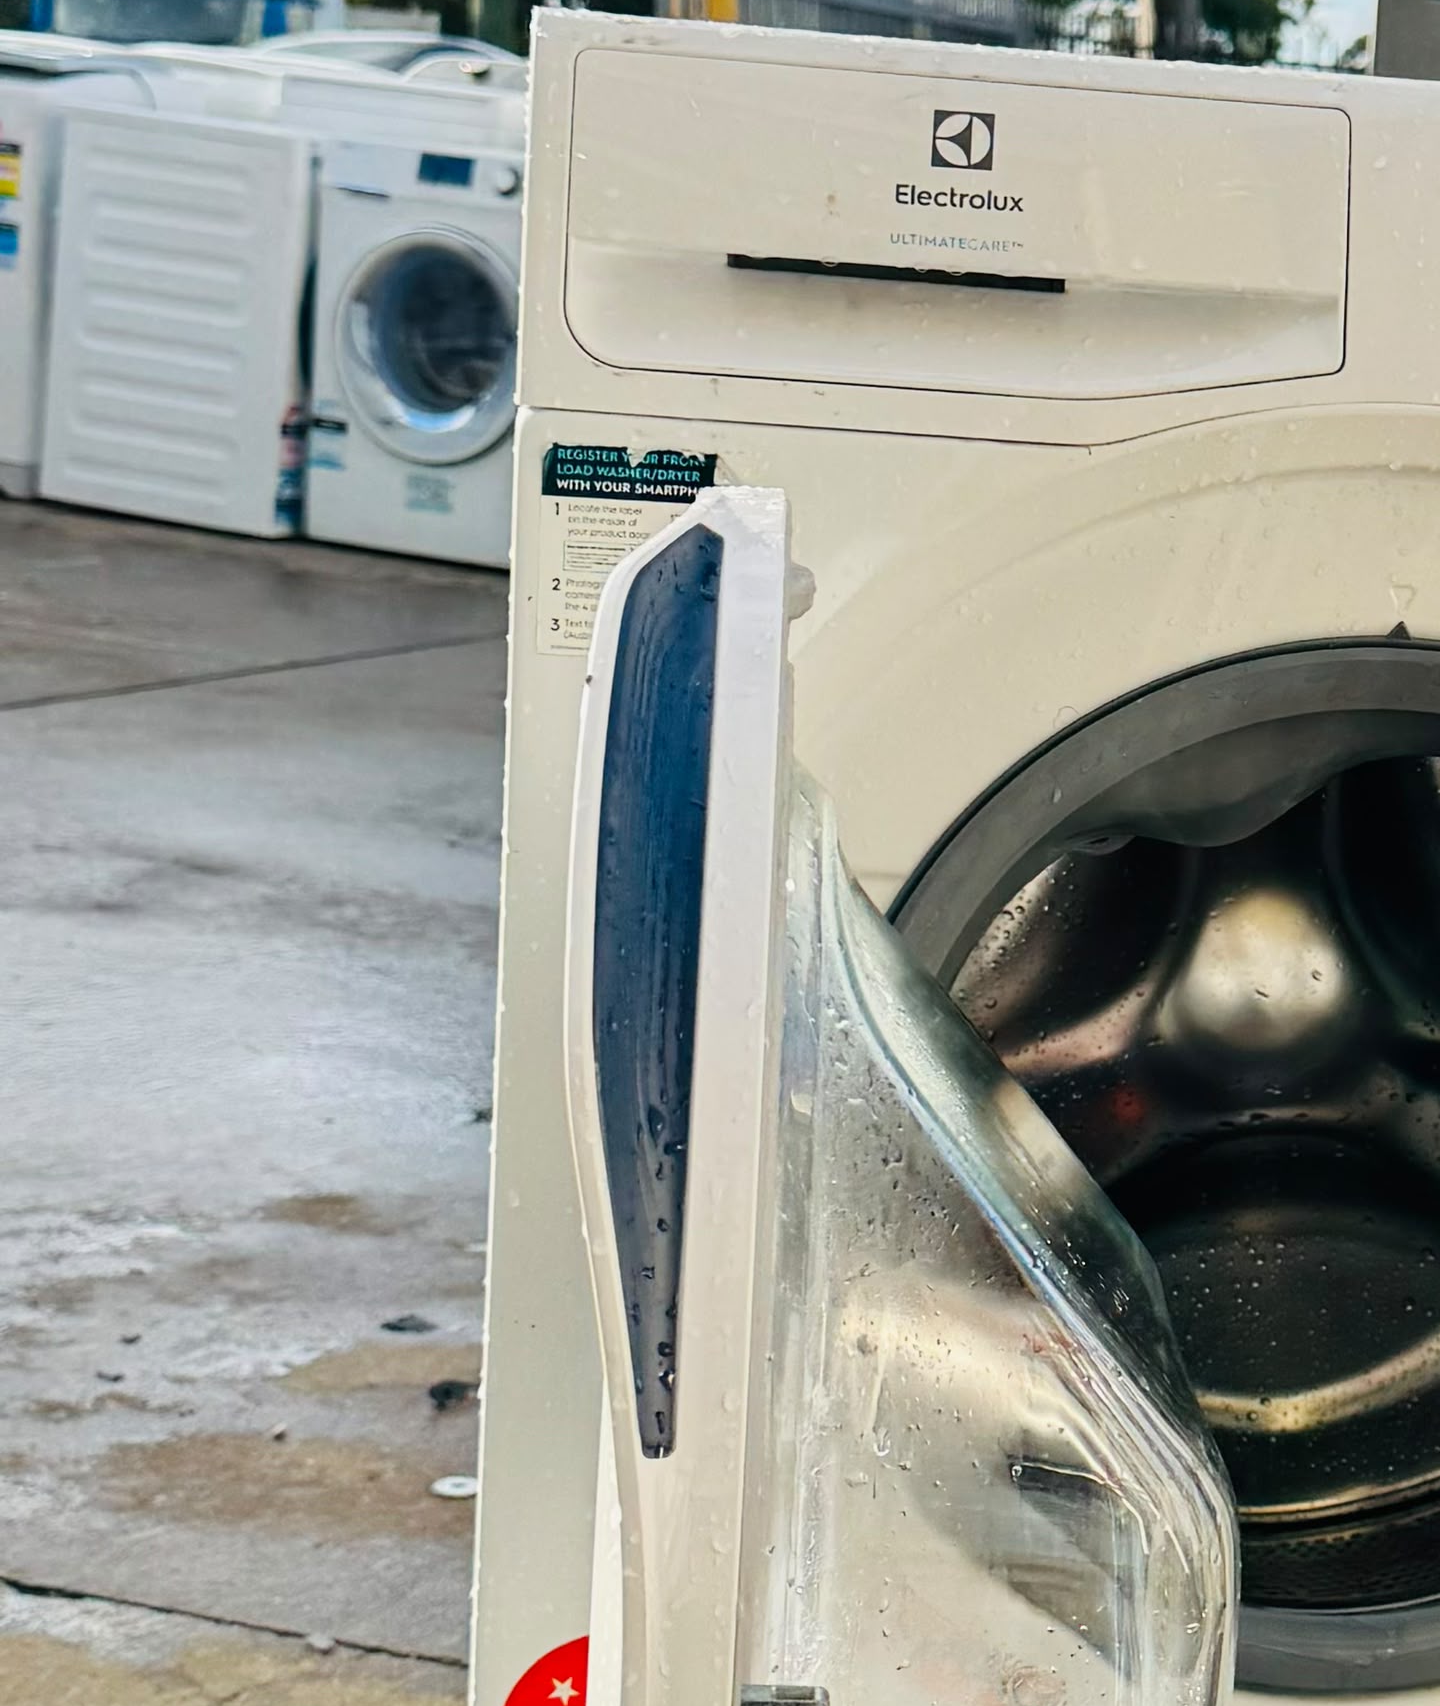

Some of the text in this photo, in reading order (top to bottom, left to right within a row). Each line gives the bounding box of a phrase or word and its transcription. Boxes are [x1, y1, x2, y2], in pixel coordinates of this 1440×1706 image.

[895, 183, 1023, 212] Electrolux
[558, 448, 618, 462] REGISTER
[621, 451, 658, 465] YUR
[557, 463, 701, 483] LOAD WASHER/DRYER
[556, 478, 591, 491] WITH
[593, 480, 632, 494] YOUR
[555, 502, 560, 516] 1
[552, 577, 561, 591] 2
[551, 618, 560, 631] 3
